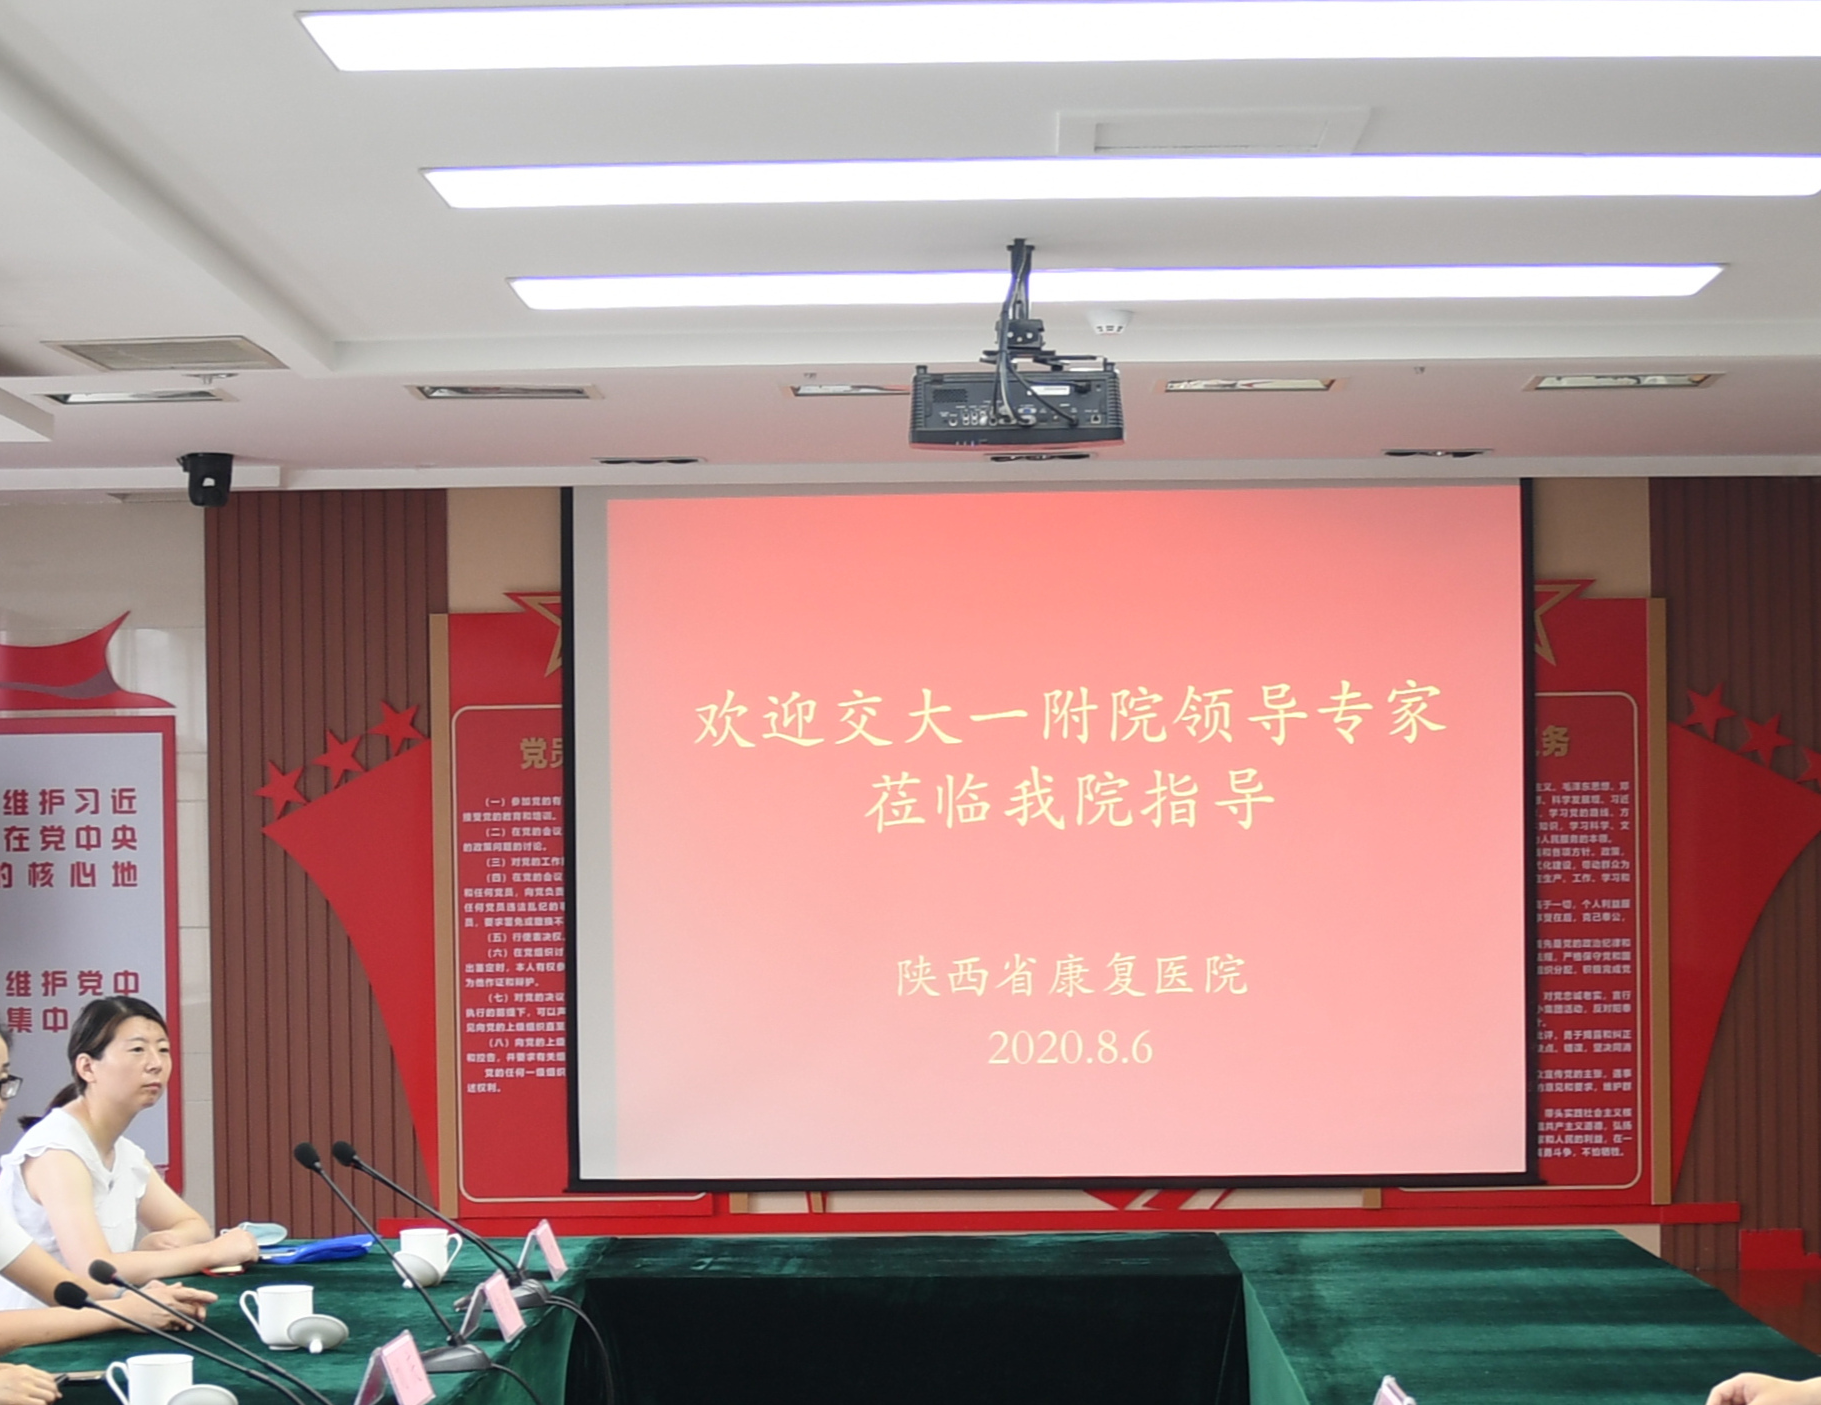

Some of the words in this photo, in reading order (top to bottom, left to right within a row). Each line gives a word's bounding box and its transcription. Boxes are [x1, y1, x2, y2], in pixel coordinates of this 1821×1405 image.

[693, 678, 1448, 749] 欢迎交大一附院领导专家
[863, 765, 1276, 834] 莅临我院指导
[895, 951, 1249, 998] 陕西省康复医院
[987, 1030, 1154, 1065] 2020.8.6
